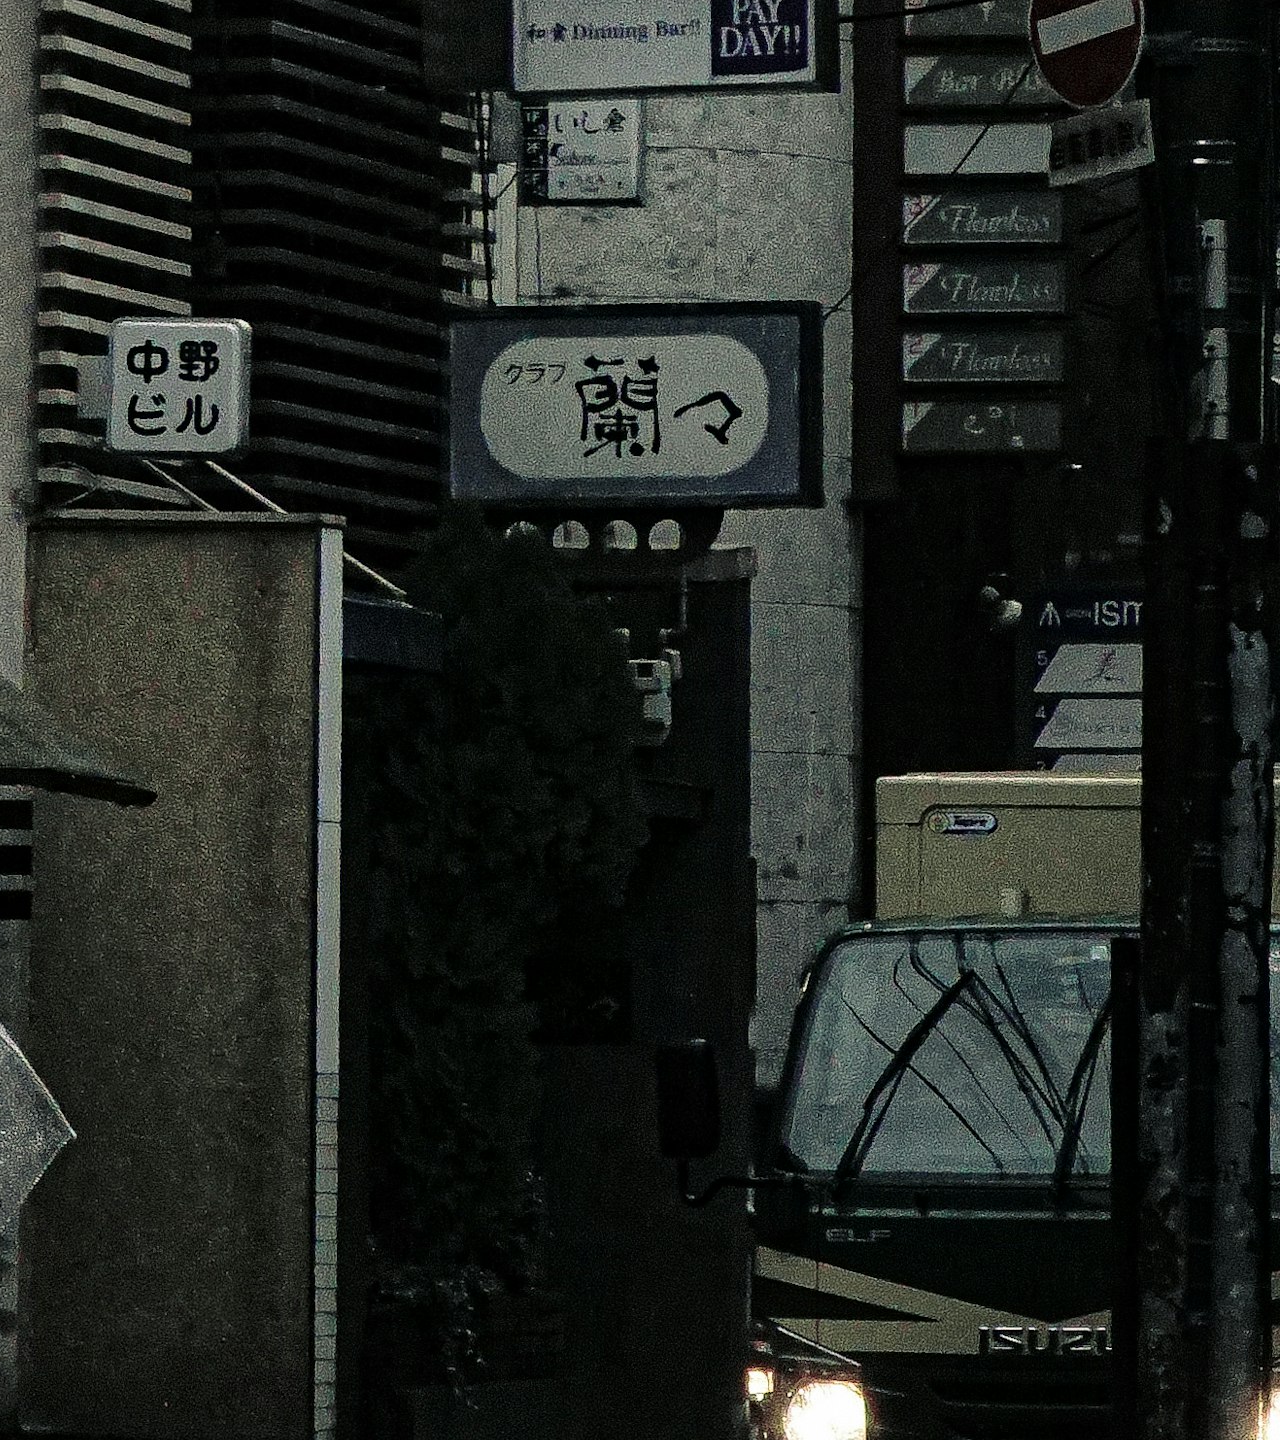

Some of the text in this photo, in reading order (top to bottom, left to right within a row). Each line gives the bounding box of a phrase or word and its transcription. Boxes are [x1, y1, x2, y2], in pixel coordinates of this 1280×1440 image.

[718, 24, 803, 59] DAY!!
[127, 340, 220, 384] 中野
[126, 393, 220, 436] ビル
[825, 1228, 891, 1243] ELF
